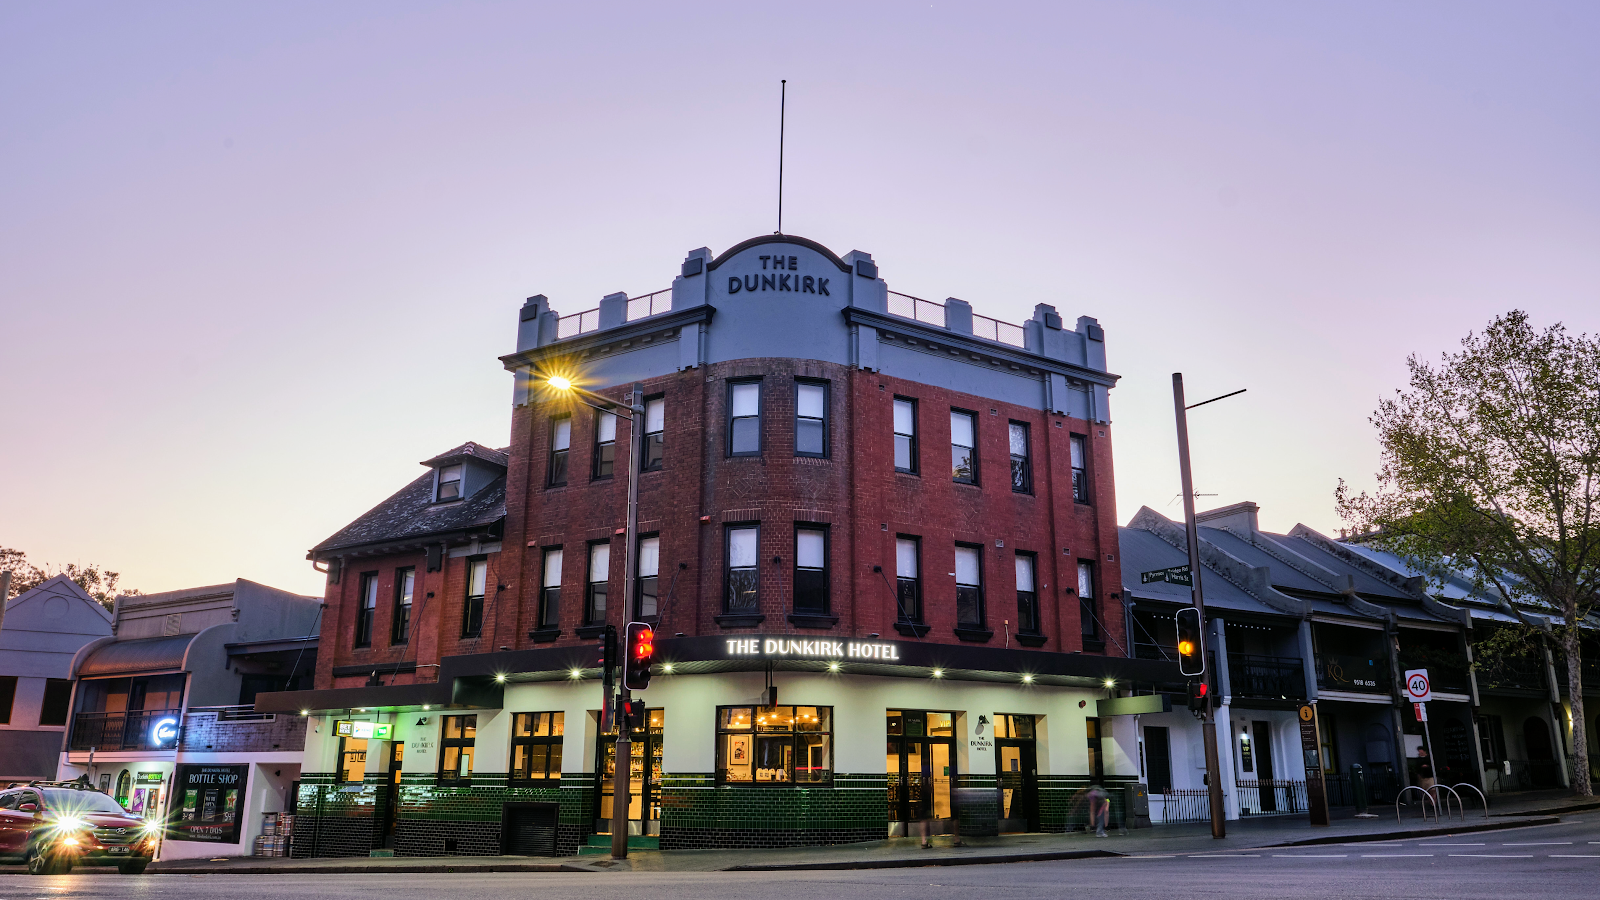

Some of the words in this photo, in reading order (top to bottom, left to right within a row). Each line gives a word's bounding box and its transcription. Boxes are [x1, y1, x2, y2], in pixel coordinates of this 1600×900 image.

[759, 255, 797, 270] THE
[728, 273, 830, 296] DUNKIRK
[726, 639, 760, 655] THE
[764, 639, 844, 657] DUNKIRK
[849, 642, 900, 660] HOTEL
[1411, 680, 1426, 691] 40
[189, 773, 216, 784] BOTTLE
[218, 774, 239, 784] SHOP
[190, 826, 204, 834] OPEN
[205, 826, 209, 834] 7
[209, 827, 223, 835] DAYS
